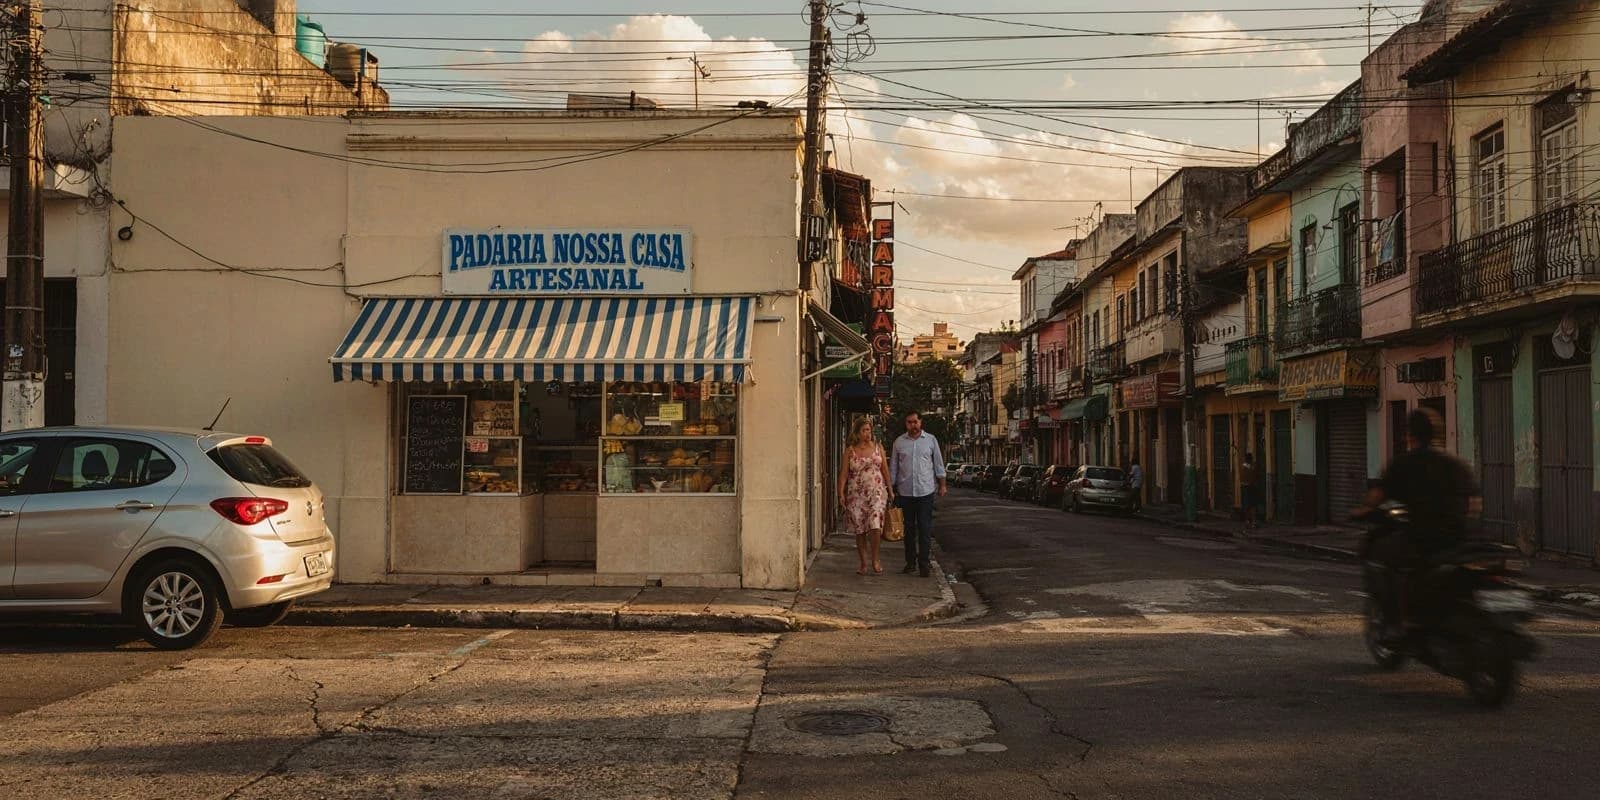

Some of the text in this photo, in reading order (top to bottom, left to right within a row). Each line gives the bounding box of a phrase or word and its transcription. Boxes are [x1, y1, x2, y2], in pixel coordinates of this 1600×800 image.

[449, 233, 686, 272] PADARIA NOSSA CASA
[489, 268, 644, 291] ARTESANAL
[872, 220, 892, 397] FARMACI
[1281, 358, 1341, 387] BARBEARIA
